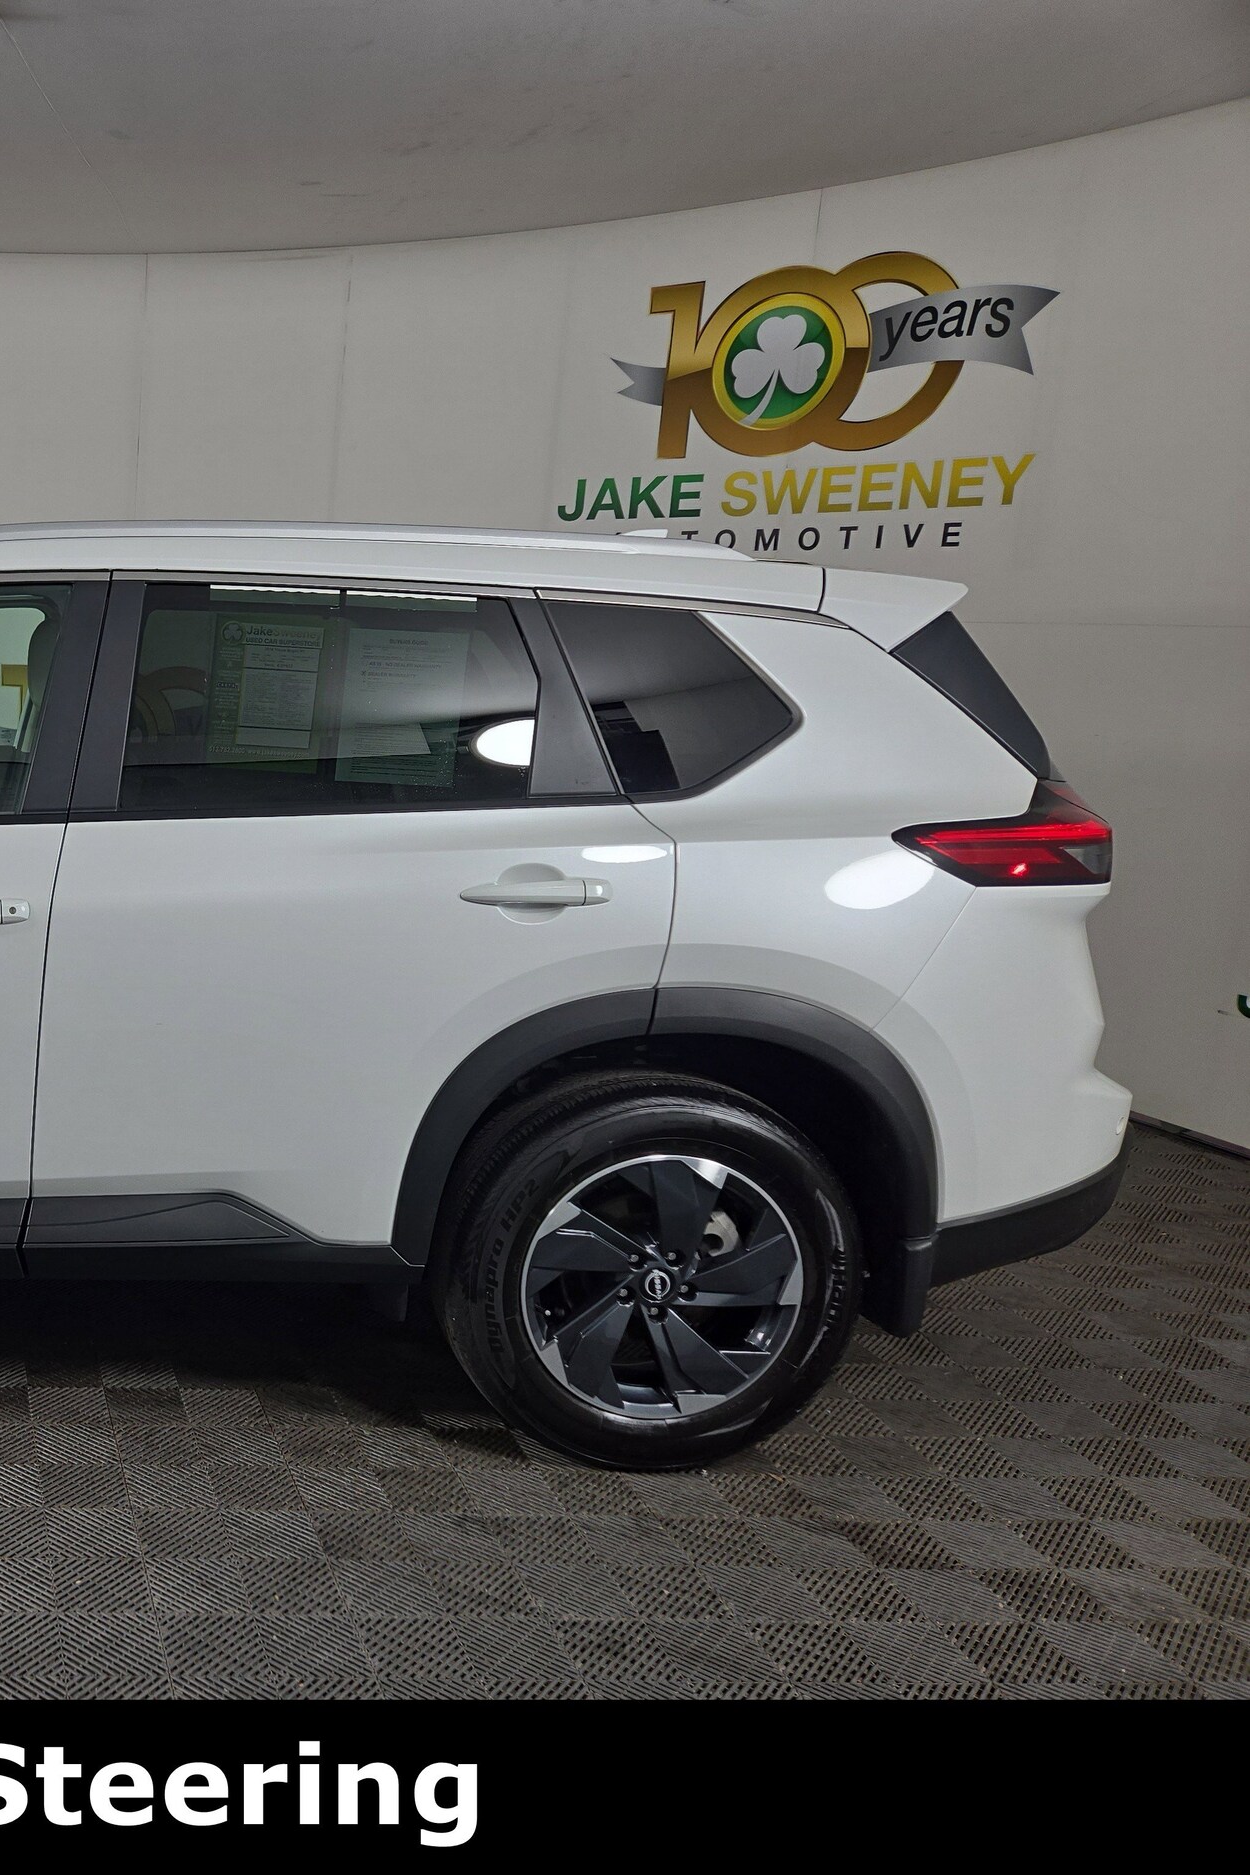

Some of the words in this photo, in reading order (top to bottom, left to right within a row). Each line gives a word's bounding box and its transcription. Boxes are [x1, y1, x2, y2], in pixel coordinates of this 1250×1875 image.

[879, 296, 1015, 361] years
[558, 473, 705, 522] JAKE
[720, 453, 1036, 517] SWEENEY
[616, 522, 963, 552] TOMOTIVE
